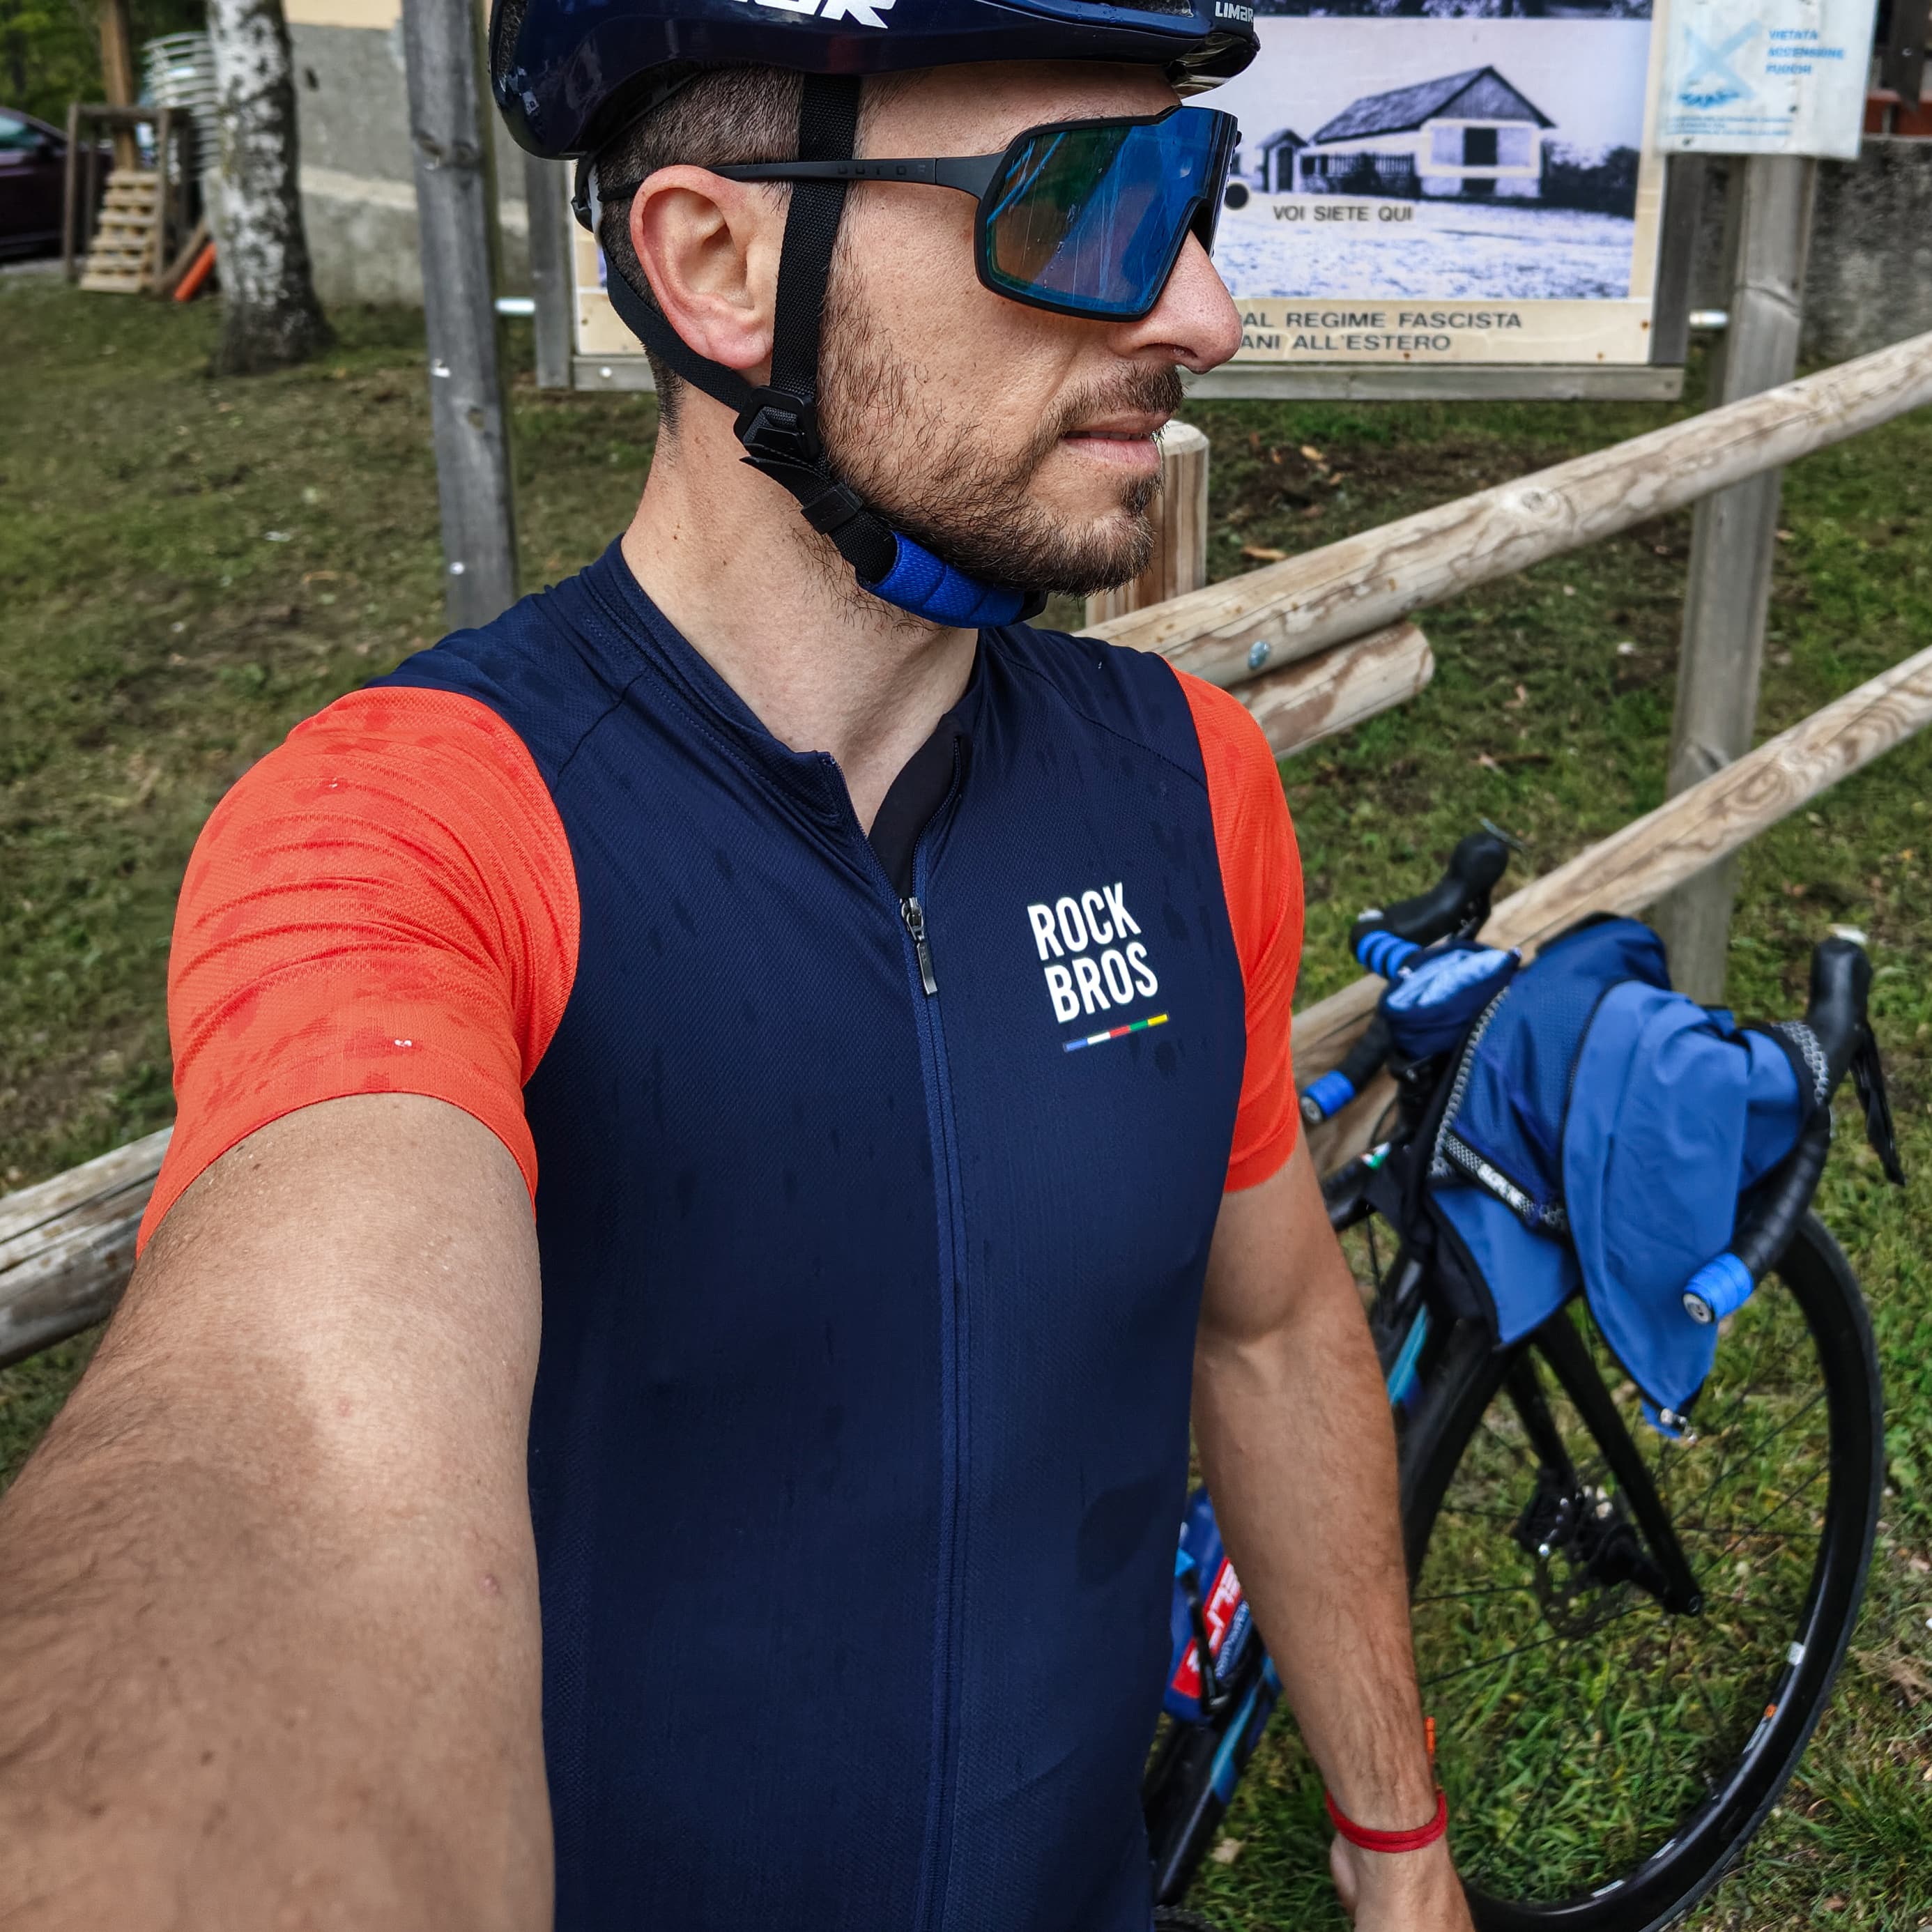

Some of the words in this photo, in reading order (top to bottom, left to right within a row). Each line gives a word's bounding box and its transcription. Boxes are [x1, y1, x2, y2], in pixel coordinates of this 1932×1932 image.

[1273, 206, 1305, 221] VOI
[1314, 206, 1369, 222] SIETE
[1378, 206, 1412, 222] QUI
[1243, 312, 1274, 327] AL
[1287, 312, 1386, 328] REGIME
[1398, 312, 1521, 328] FASCISTA
[1293, 335, 1451, 350] ALL'ESTERO
[1027, 882, 1142, 960] ROCK
[1044, 942, 1158, 1024] BROS
